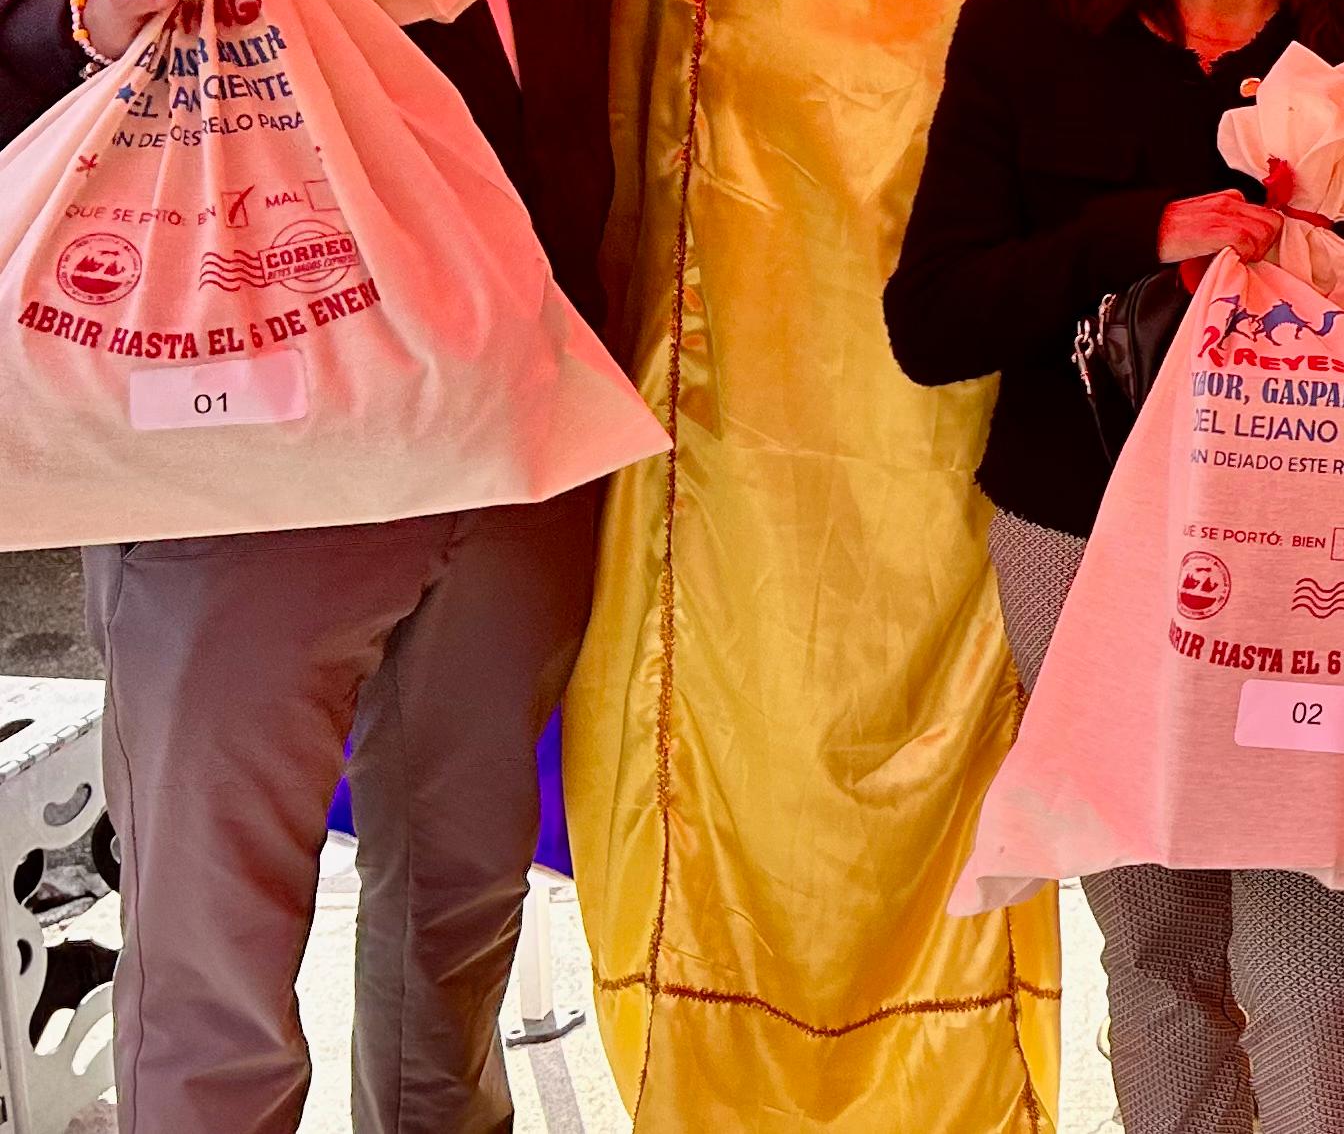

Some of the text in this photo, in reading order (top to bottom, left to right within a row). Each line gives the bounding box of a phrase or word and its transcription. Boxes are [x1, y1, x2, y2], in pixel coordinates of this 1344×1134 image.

[112, 209, 134, 222] SE
[265, 191, 304, 209] MAL
[266, 238, 354, 269] CORREO
[18, 299, 102, 349] ABRIR
[108, 327, 200, 360] HASTA
[208, 327, 245, 356] EL
[250, 327, 264, 349] 6
[266, 309, 307, 342] DE
[193, 392, 229, 415] 01
[1234, 413, 1339, 444] LEJANO
[1213, 451, 1284, 472] DEJADO
[1288, 457, 1329, 475] ESTE
[1201, 527, 1219, 540] SE
[1223, 525, 1283, 547] PORTÓ:
[1292, 535, 1327, 549] BIEN
[1209, 640, 1283, 674] HASTA
[1291, 650, 1320, 675] EL
[1327, 650, 1341, 675] 6
[1291, 702, 1324, 725] 02
